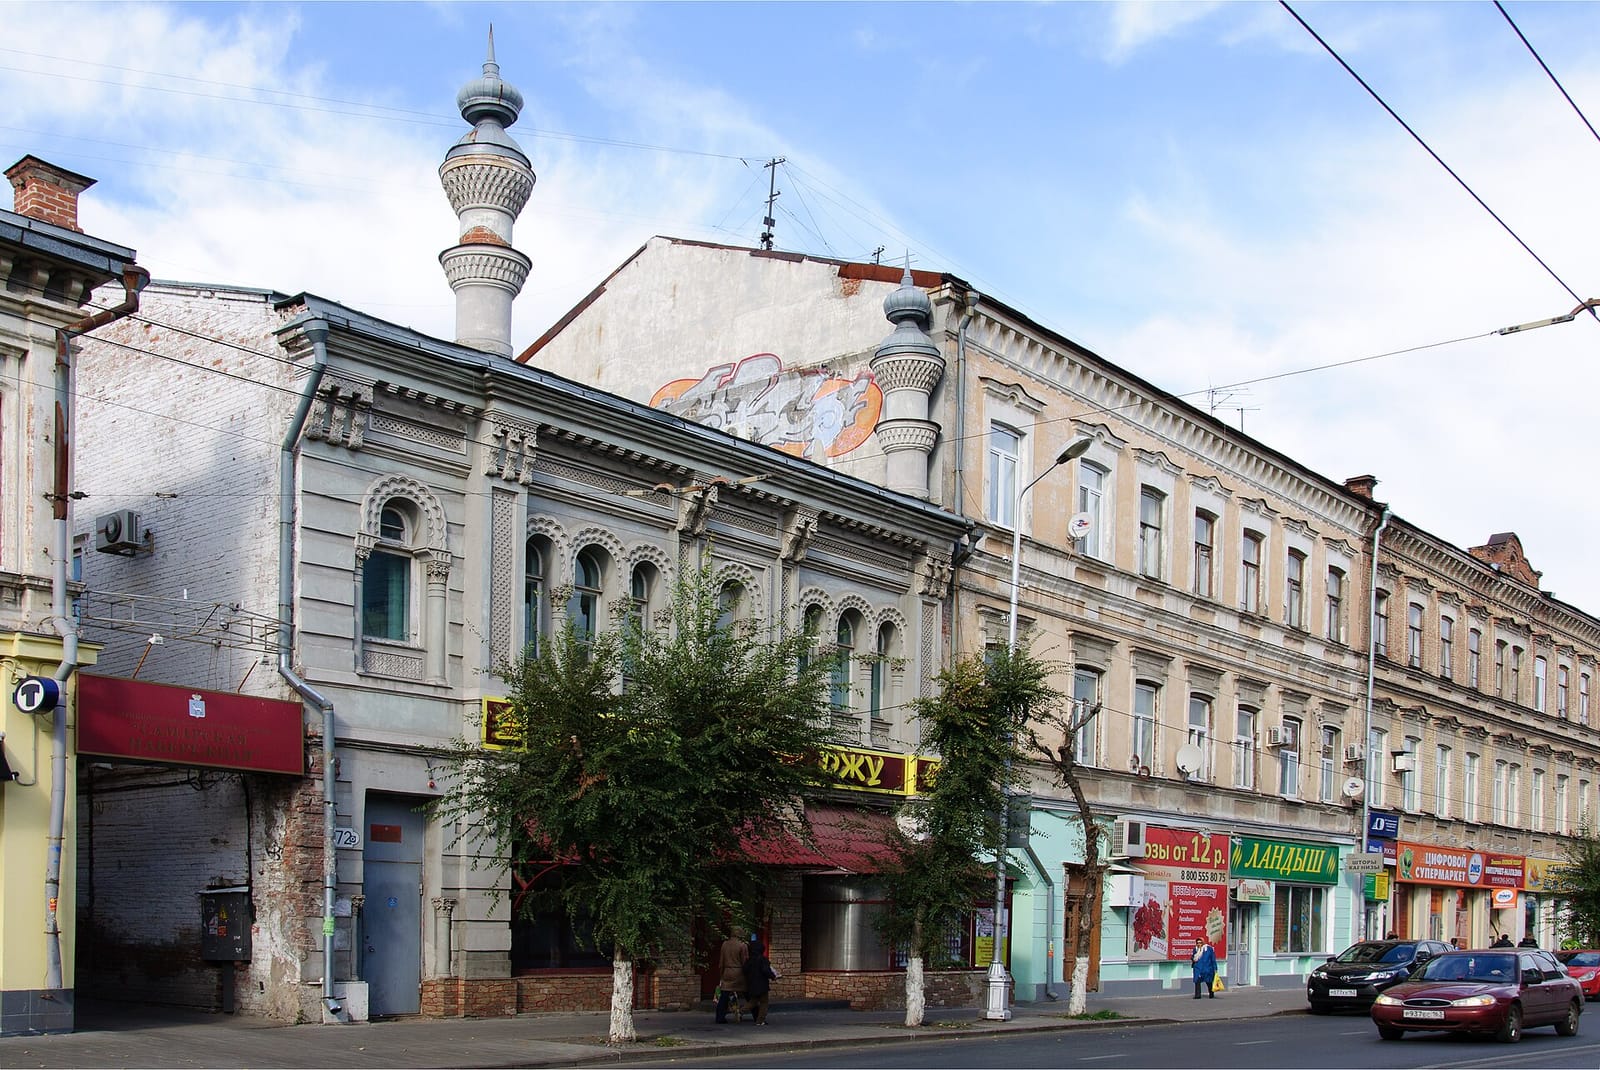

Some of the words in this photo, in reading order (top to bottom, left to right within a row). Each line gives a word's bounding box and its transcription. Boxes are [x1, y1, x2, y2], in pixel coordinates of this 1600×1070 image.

[1145, 843, 1170, 860] озы
[1173, 845, 1188, 862] от
[1191, 835, 1211, 863] 12
[1214, 849, 1226, 868] р.
[1244, 843, 1326, 876] ЛАНДЫШ
[1425, 852, 1467, 868] ЦИФРОВОЙ
[1415, 867, 1466, 882] СУПЕРМАРКЕТ
[1470, 864, 1481, 873] DNS
[1180, 870, 1186, 881] 8
[1186, 870, 1197, 881] 800
[1198, 871, 1209, 882] 555
[1218, 873, 1226, 883] 75
